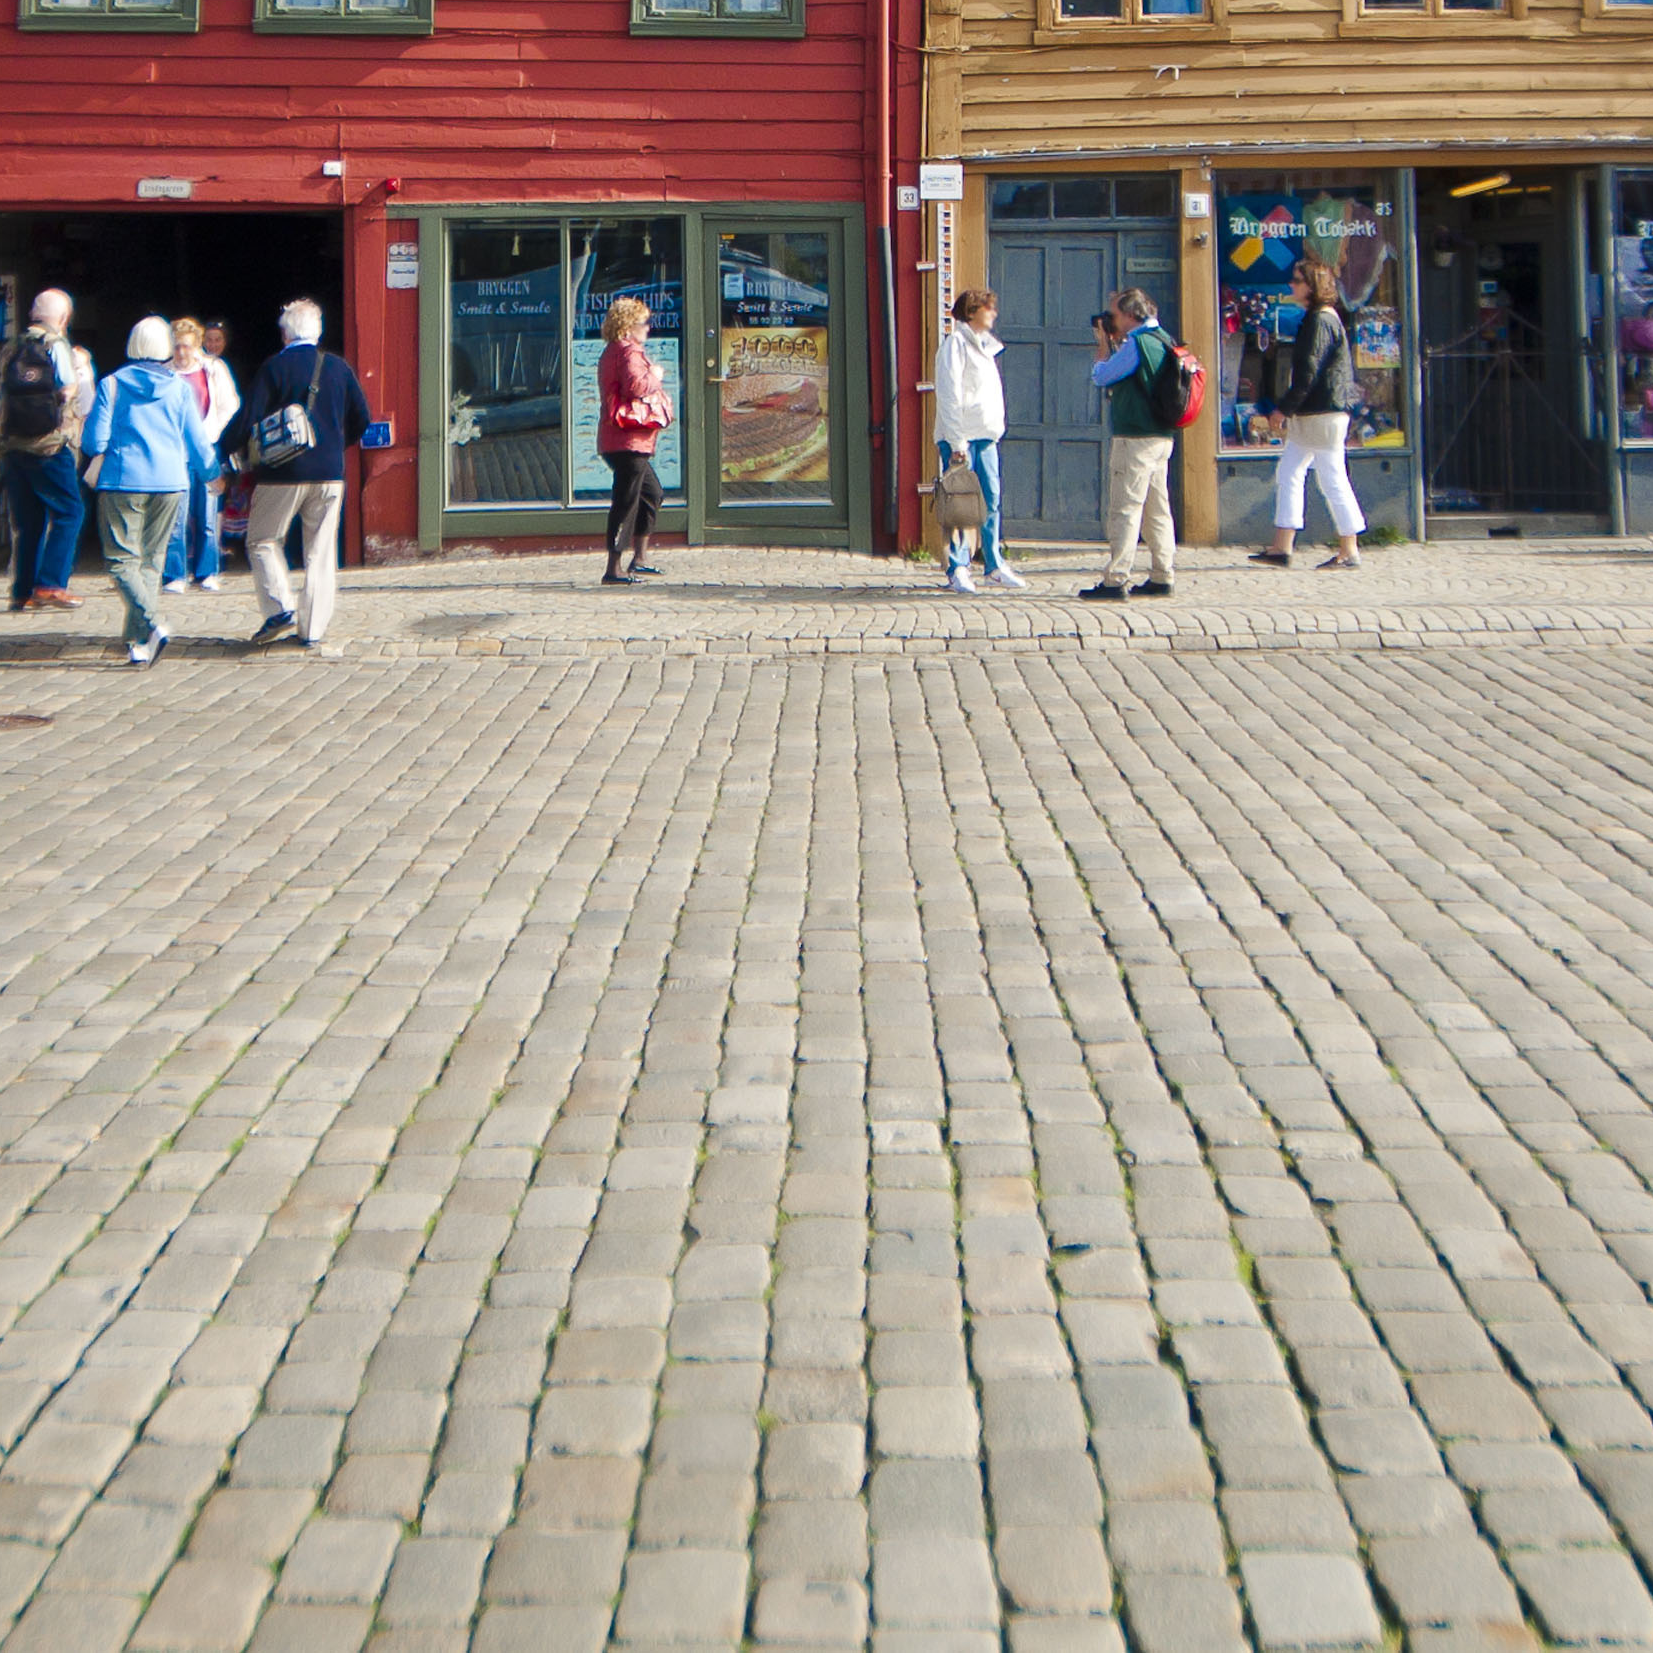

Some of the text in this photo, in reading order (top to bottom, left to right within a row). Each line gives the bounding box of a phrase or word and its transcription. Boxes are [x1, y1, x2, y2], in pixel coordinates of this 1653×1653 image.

[904, 192, 915, 204] 33
[1229, 216, 1377, 238] Bryggen Tobakk
[477, 280, 531, 296] BRYGGEN
[495, 301, 507, 314] &
